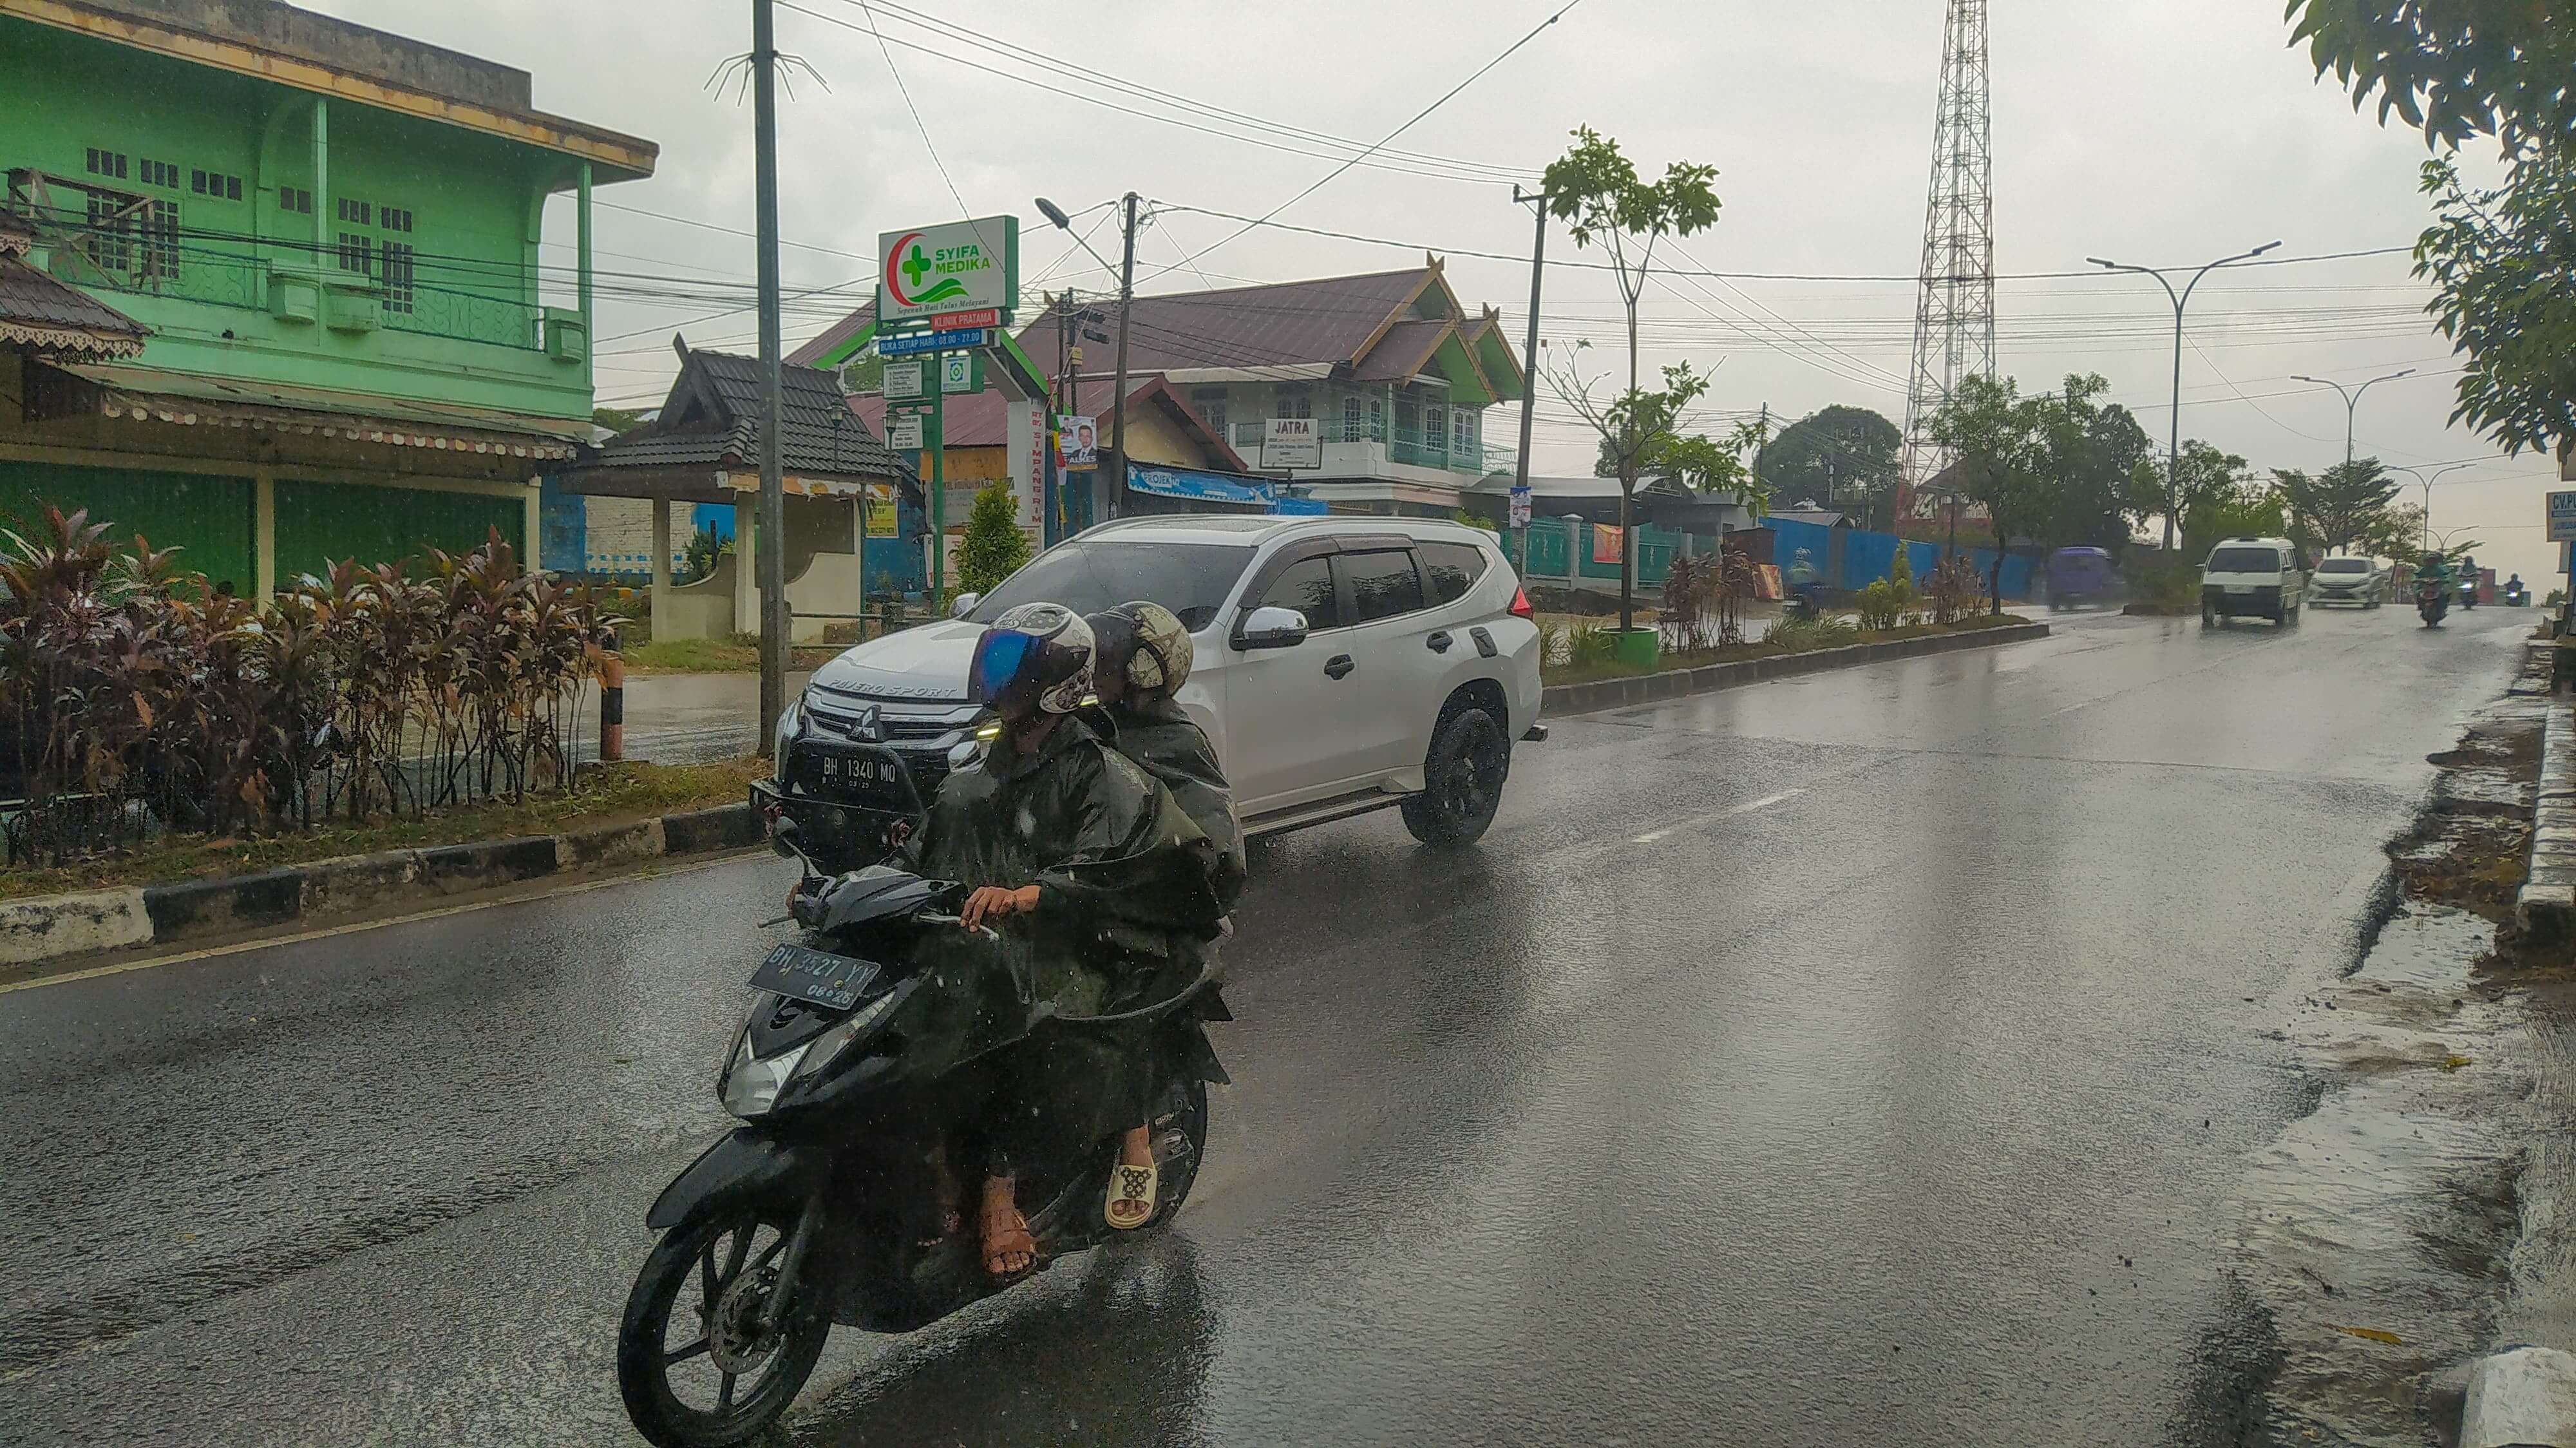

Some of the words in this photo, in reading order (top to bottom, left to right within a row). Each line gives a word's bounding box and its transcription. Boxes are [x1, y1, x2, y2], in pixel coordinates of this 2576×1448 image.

[936, 245, 980, 262] SYIFA
[936, 258, 990, 274] MEDIKA
[940, 301, 957, 310] Tulus
[960, 298, 990, 308] Melayani
[934, 315, 958, 327] KLINIK
[958, 312, 992, 325] PRATAMA
[880, 341, 897, 352] BUKA
[898, 338, 918, 350] SETIAP
[1274, 421, 1310, 435] JATRA
[829, 679, 886, 694] PAJERO
[886, 685, 958, 698] SPORT
[824, 756, 838, 776] BH
[847, 759, 874, 779] 1340
[768, 946, 797, 966] BH
[795, 953, 842, 978] 3527
